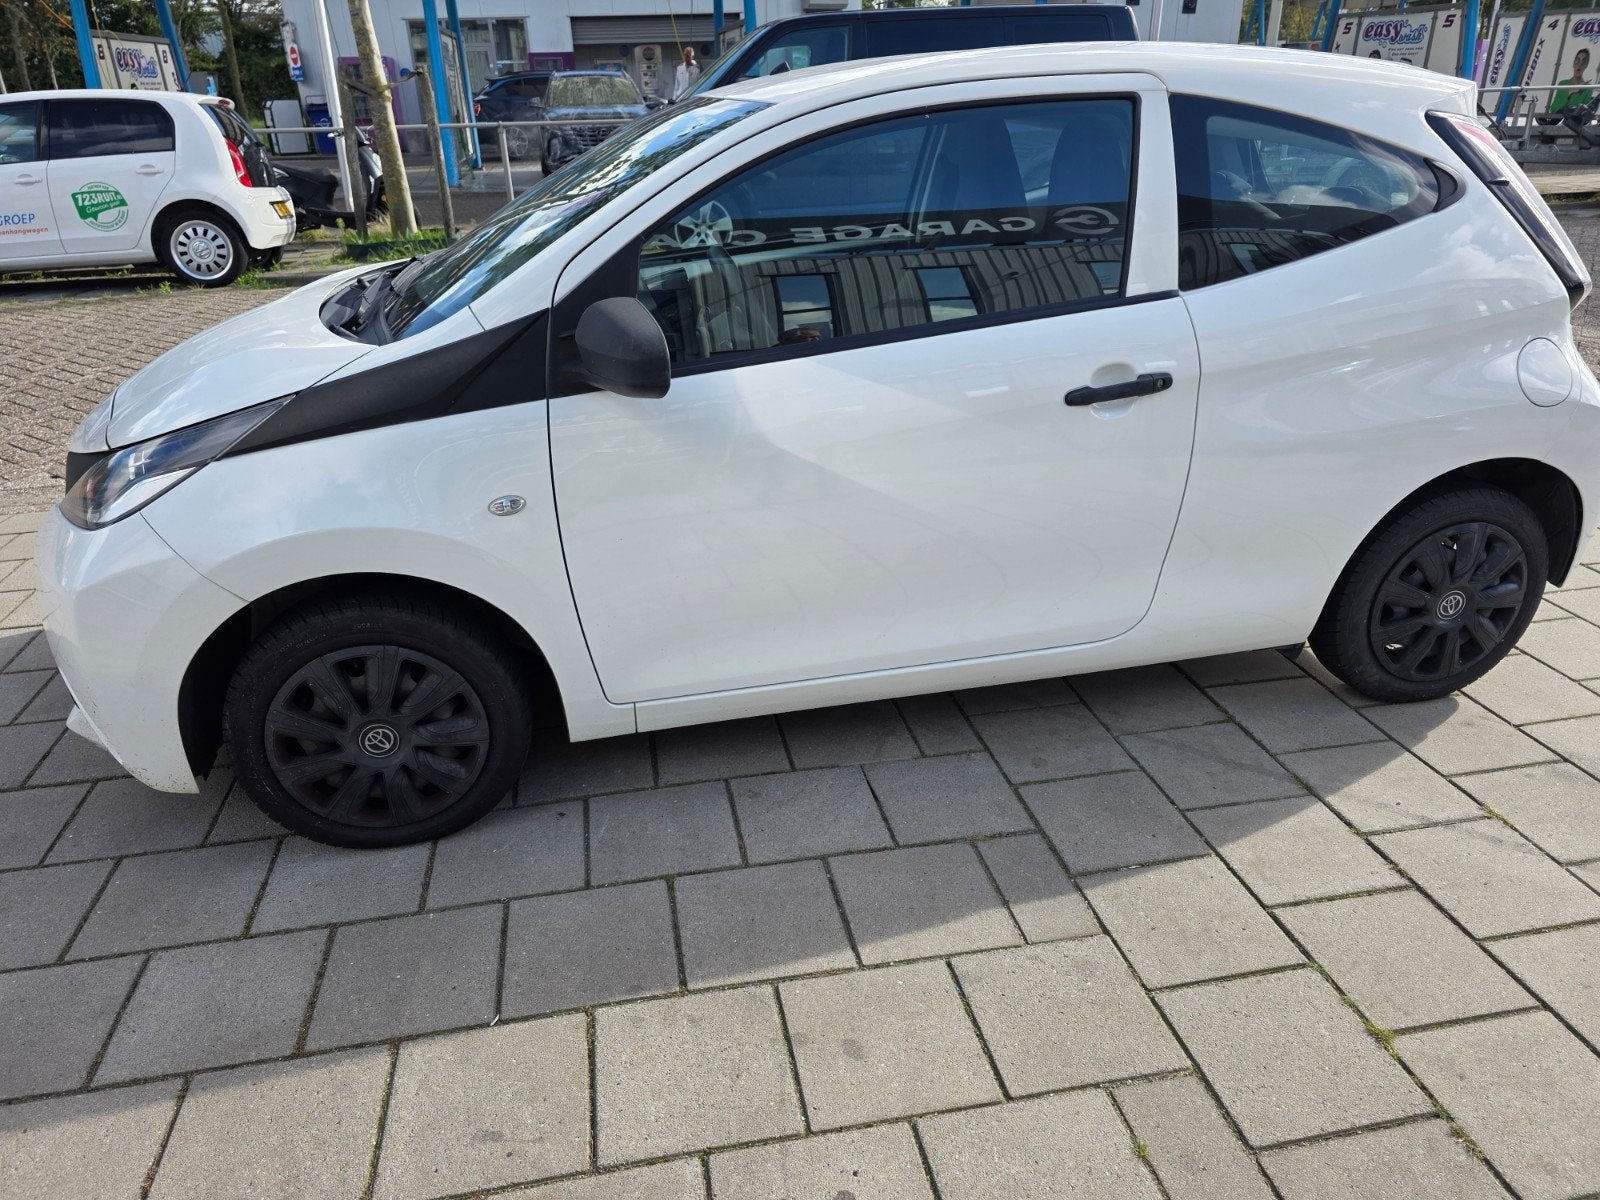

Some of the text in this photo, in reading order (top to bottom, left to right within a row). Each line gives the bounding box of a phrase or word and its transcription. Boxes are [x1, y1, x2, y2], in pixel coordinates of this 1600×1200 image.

[1342, 22, 1353, 35] 5
[1442, 14, 1457, 28] 5
[1547, 19, 1560, 31] 4
[1364, 21, 1403, 42] easy
[116, 47, 142, 76] easy
[1490, 47, 1505, 86] easy
